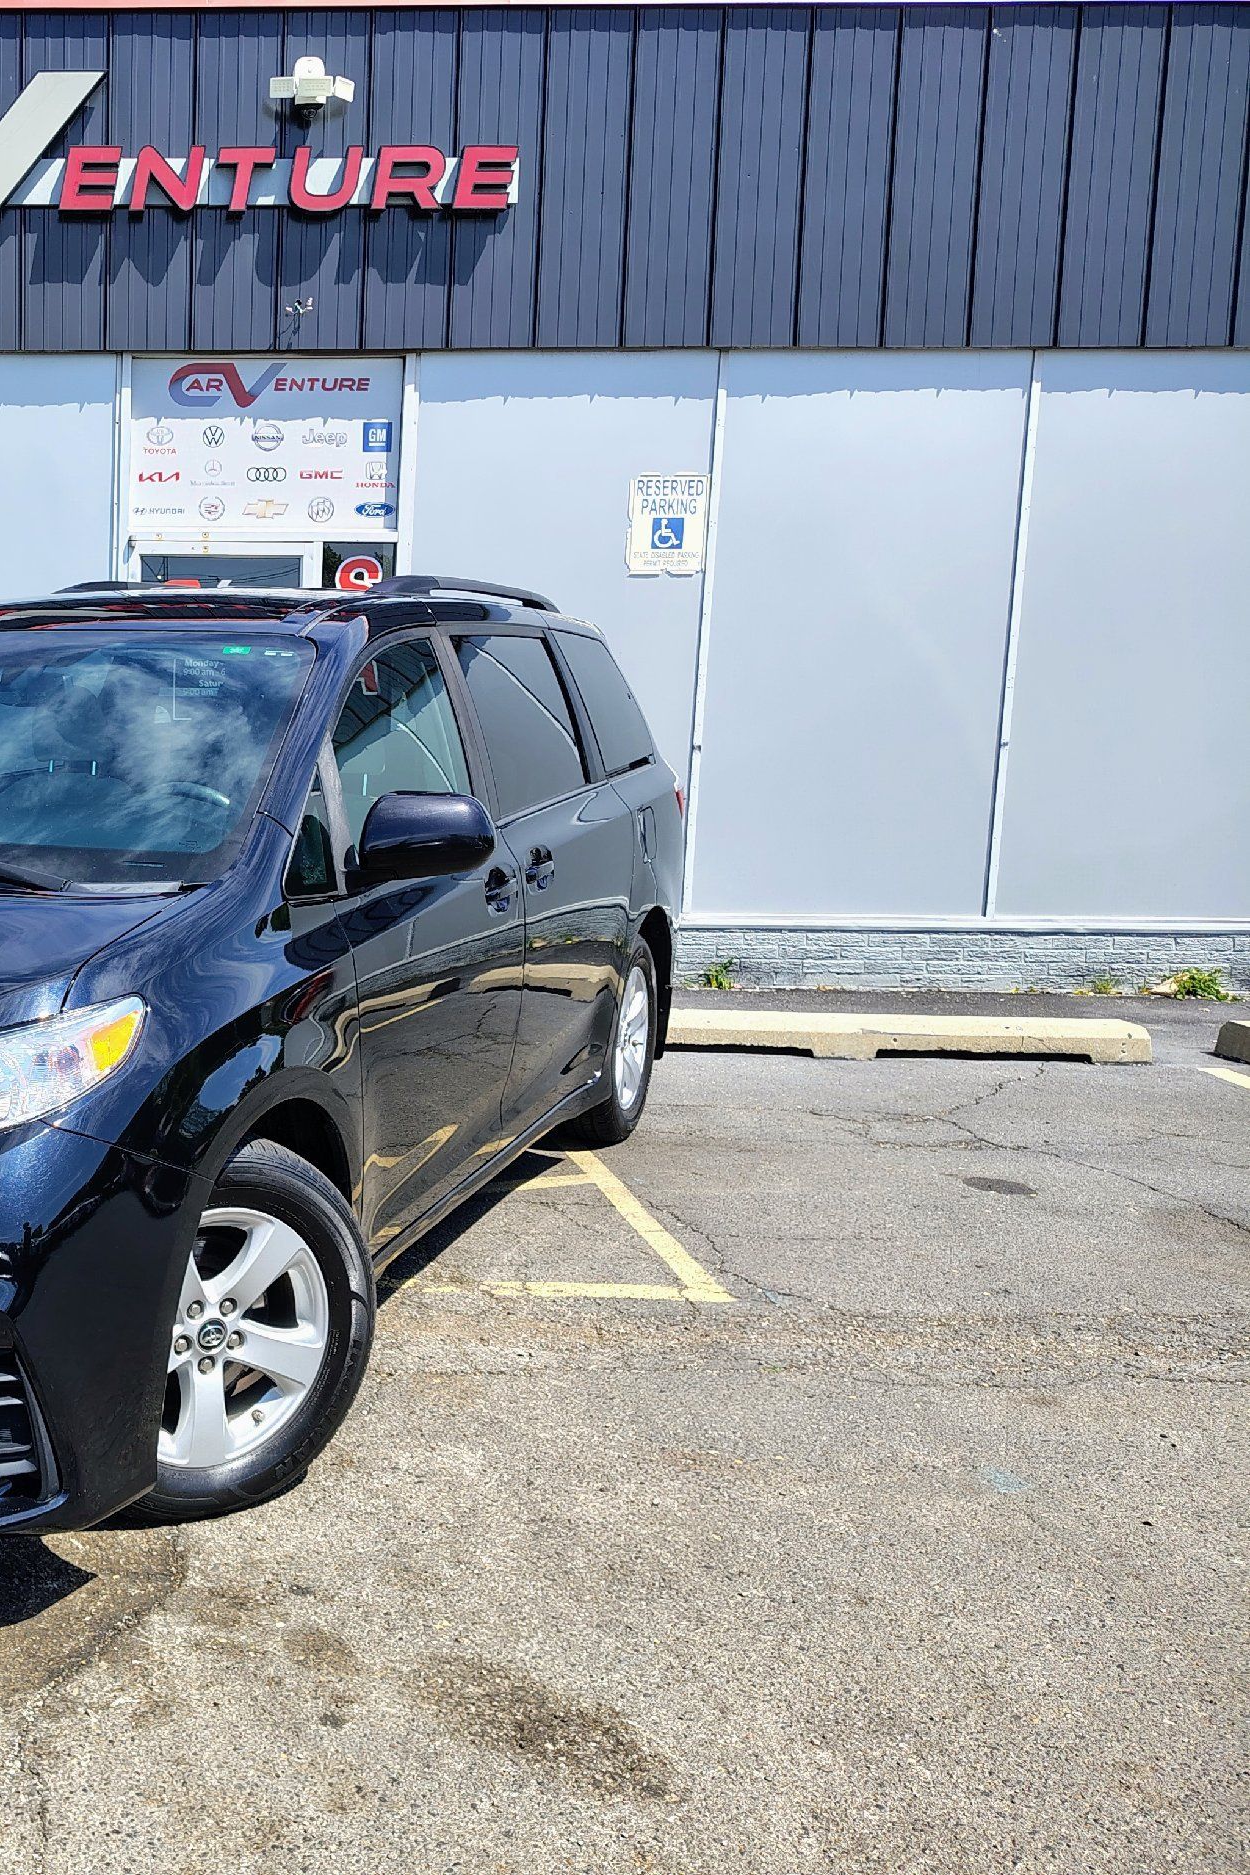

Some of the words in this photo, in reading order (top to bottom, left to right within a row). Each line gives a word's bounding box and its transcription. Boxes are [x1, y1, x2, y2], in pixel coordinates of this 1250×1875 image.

[302, 428, 348, 447] Jeep
[368, 428, 387, 442] GM
[299, 470, 344, 480] GMC
[636, 480, 704, 497] RESERVED
[361, 504, 388, 517] Ford
[640, 498, 697, 515] PARKING
[184, 659, 219, 669] Monday
[198, 679, 223, 687] Satur
